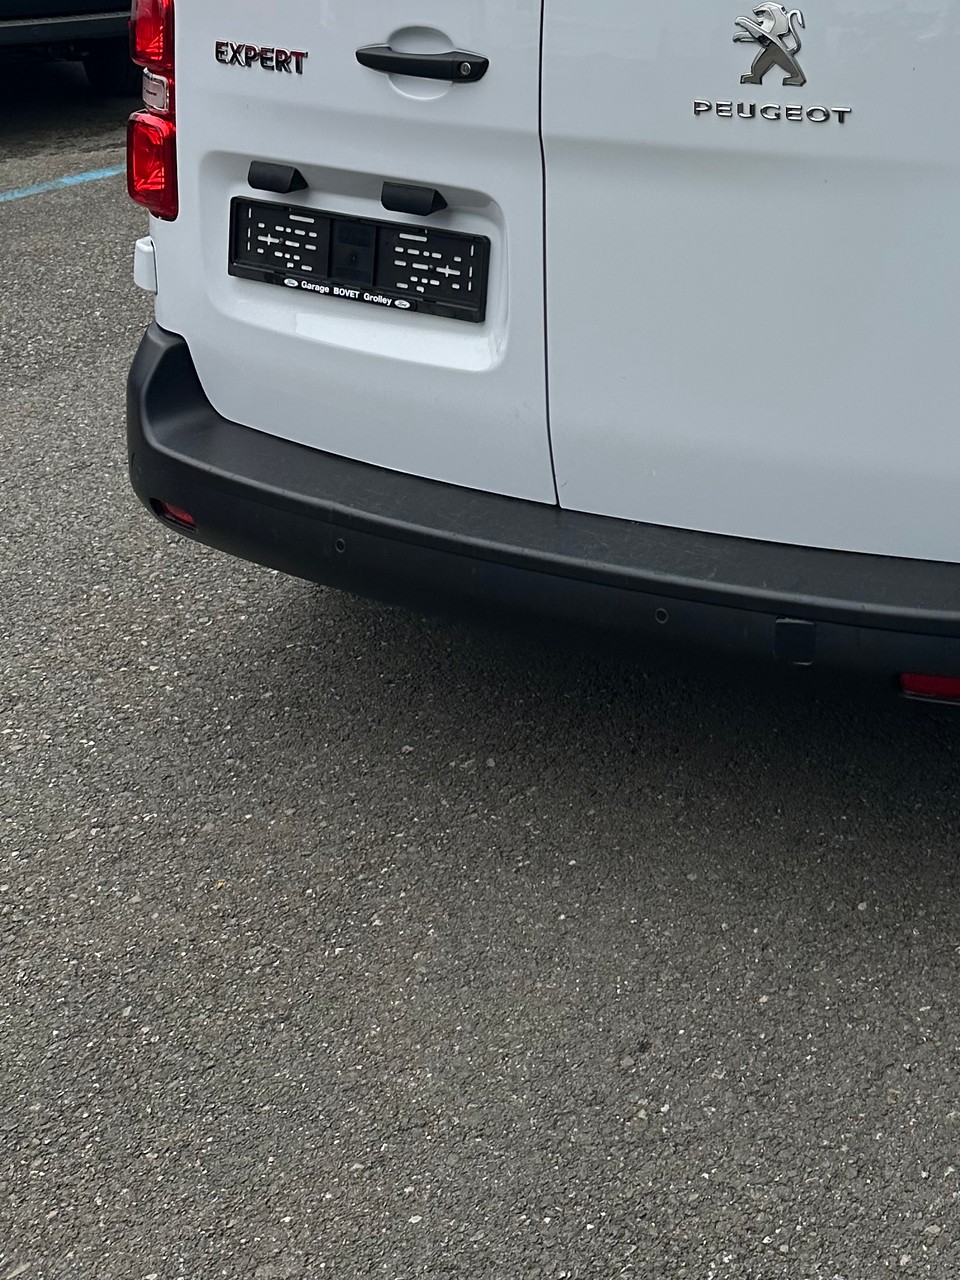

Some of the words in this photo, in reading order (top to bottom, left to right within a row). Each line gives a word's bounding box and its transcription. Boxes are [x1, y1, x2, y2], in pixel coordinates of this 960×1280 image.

[214, 40, 308, 75] EXPERT
[694, 99, 852, 124] PEUGEOT
[301, 281, 330, 293] Garage
[333, 287, 360, 299] BOVET
[363, 293, 392, 306] Grolley
